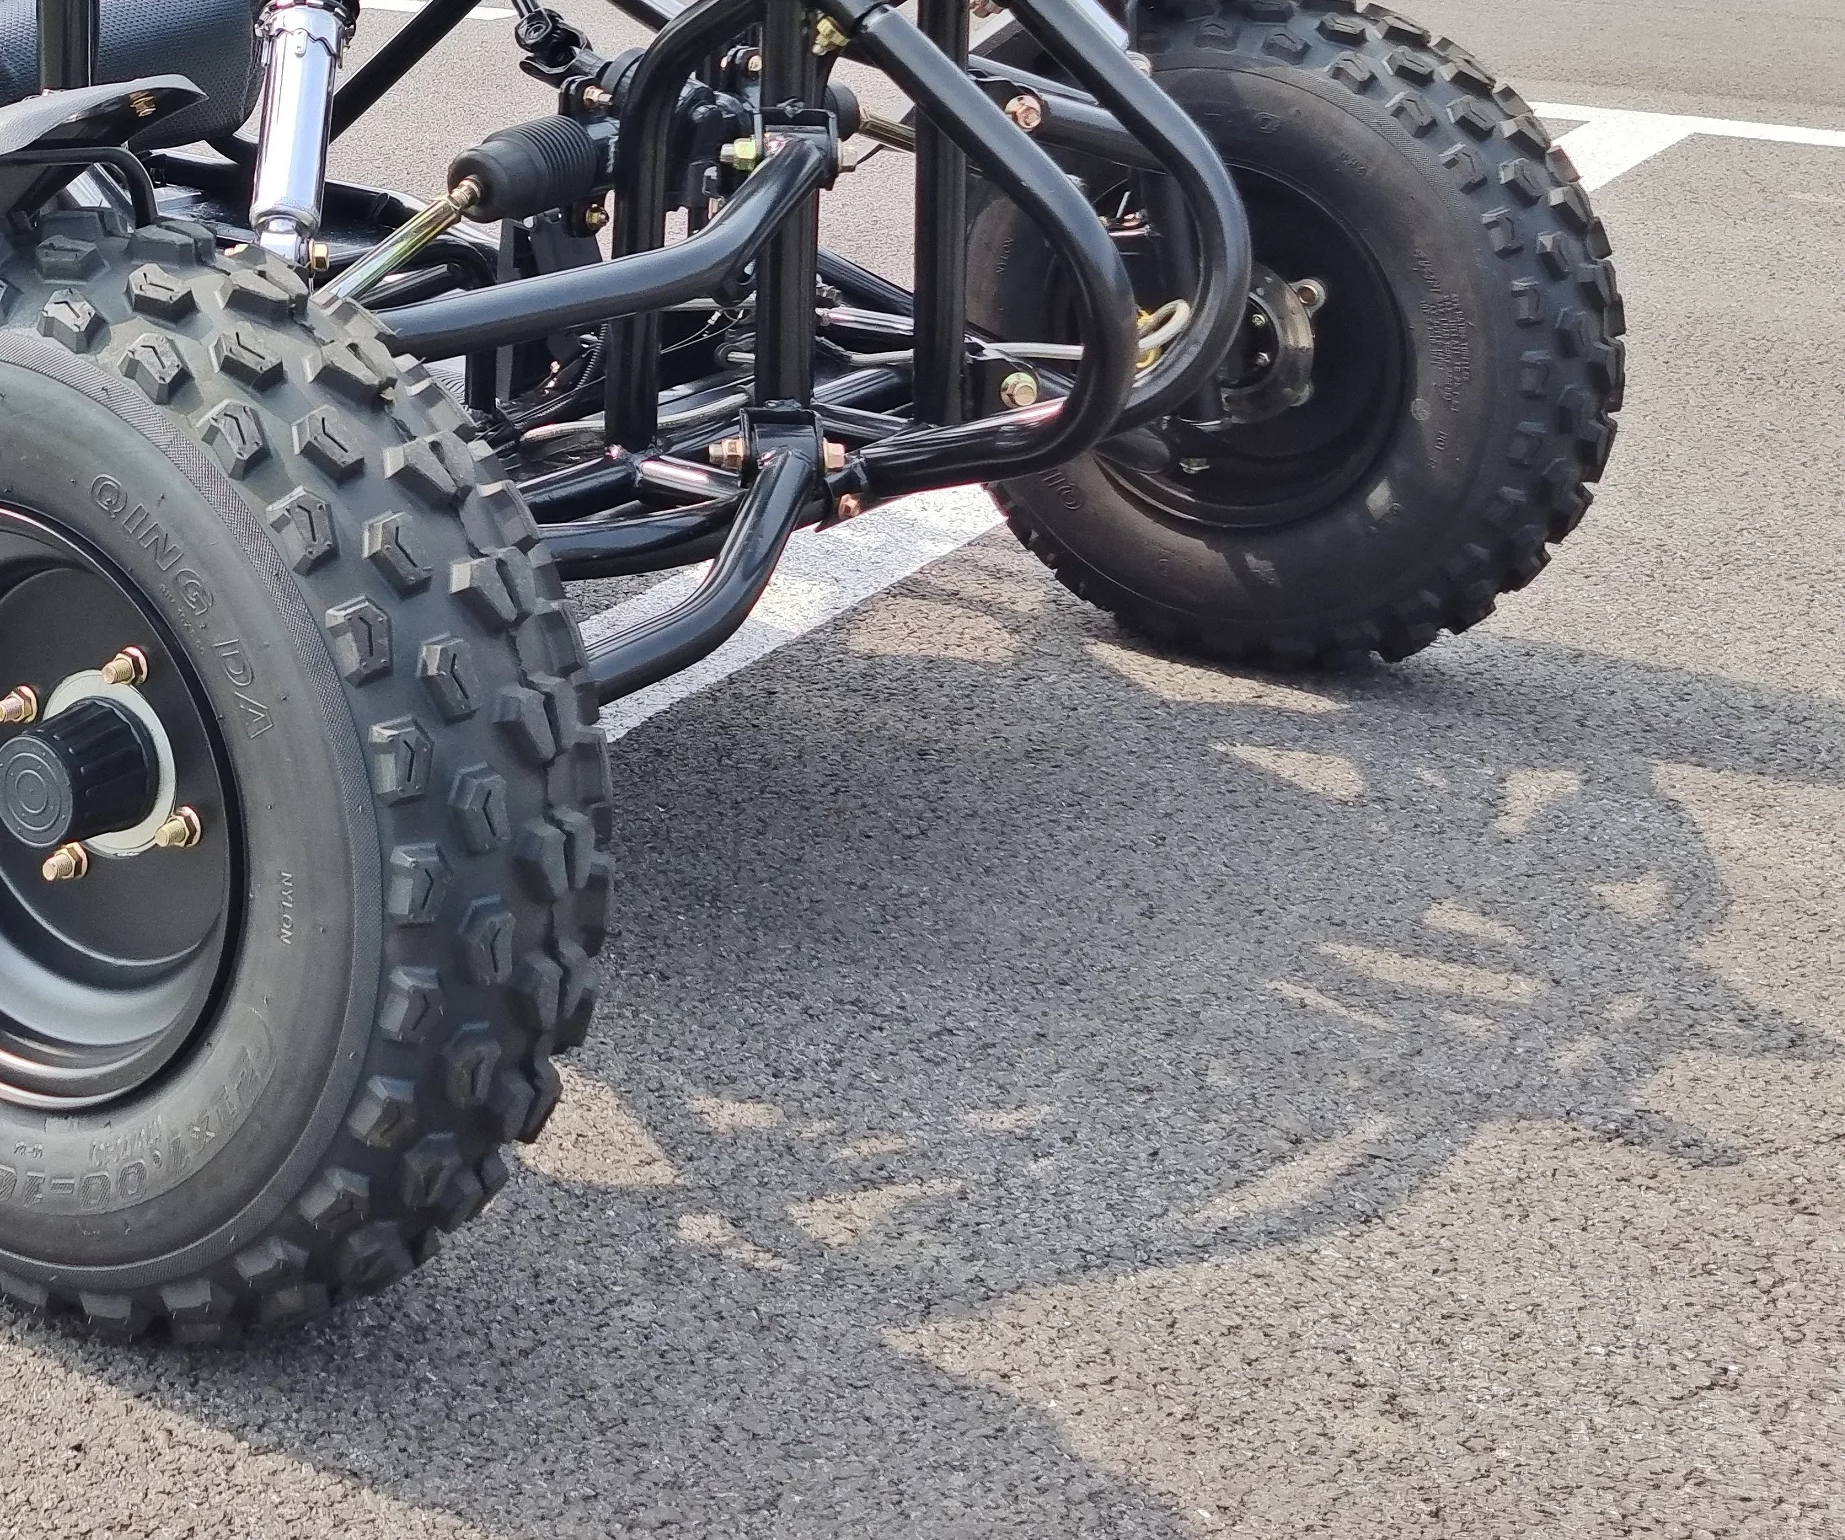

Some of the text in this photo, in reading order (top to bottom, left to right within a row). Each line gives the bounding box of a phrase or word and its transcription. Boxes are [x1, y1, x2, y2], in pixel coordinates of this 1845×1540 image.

[92, 473, 215, 613] QING
[216, 637, 273, 740] DA
[279, 870, 294, 947] NYLON
